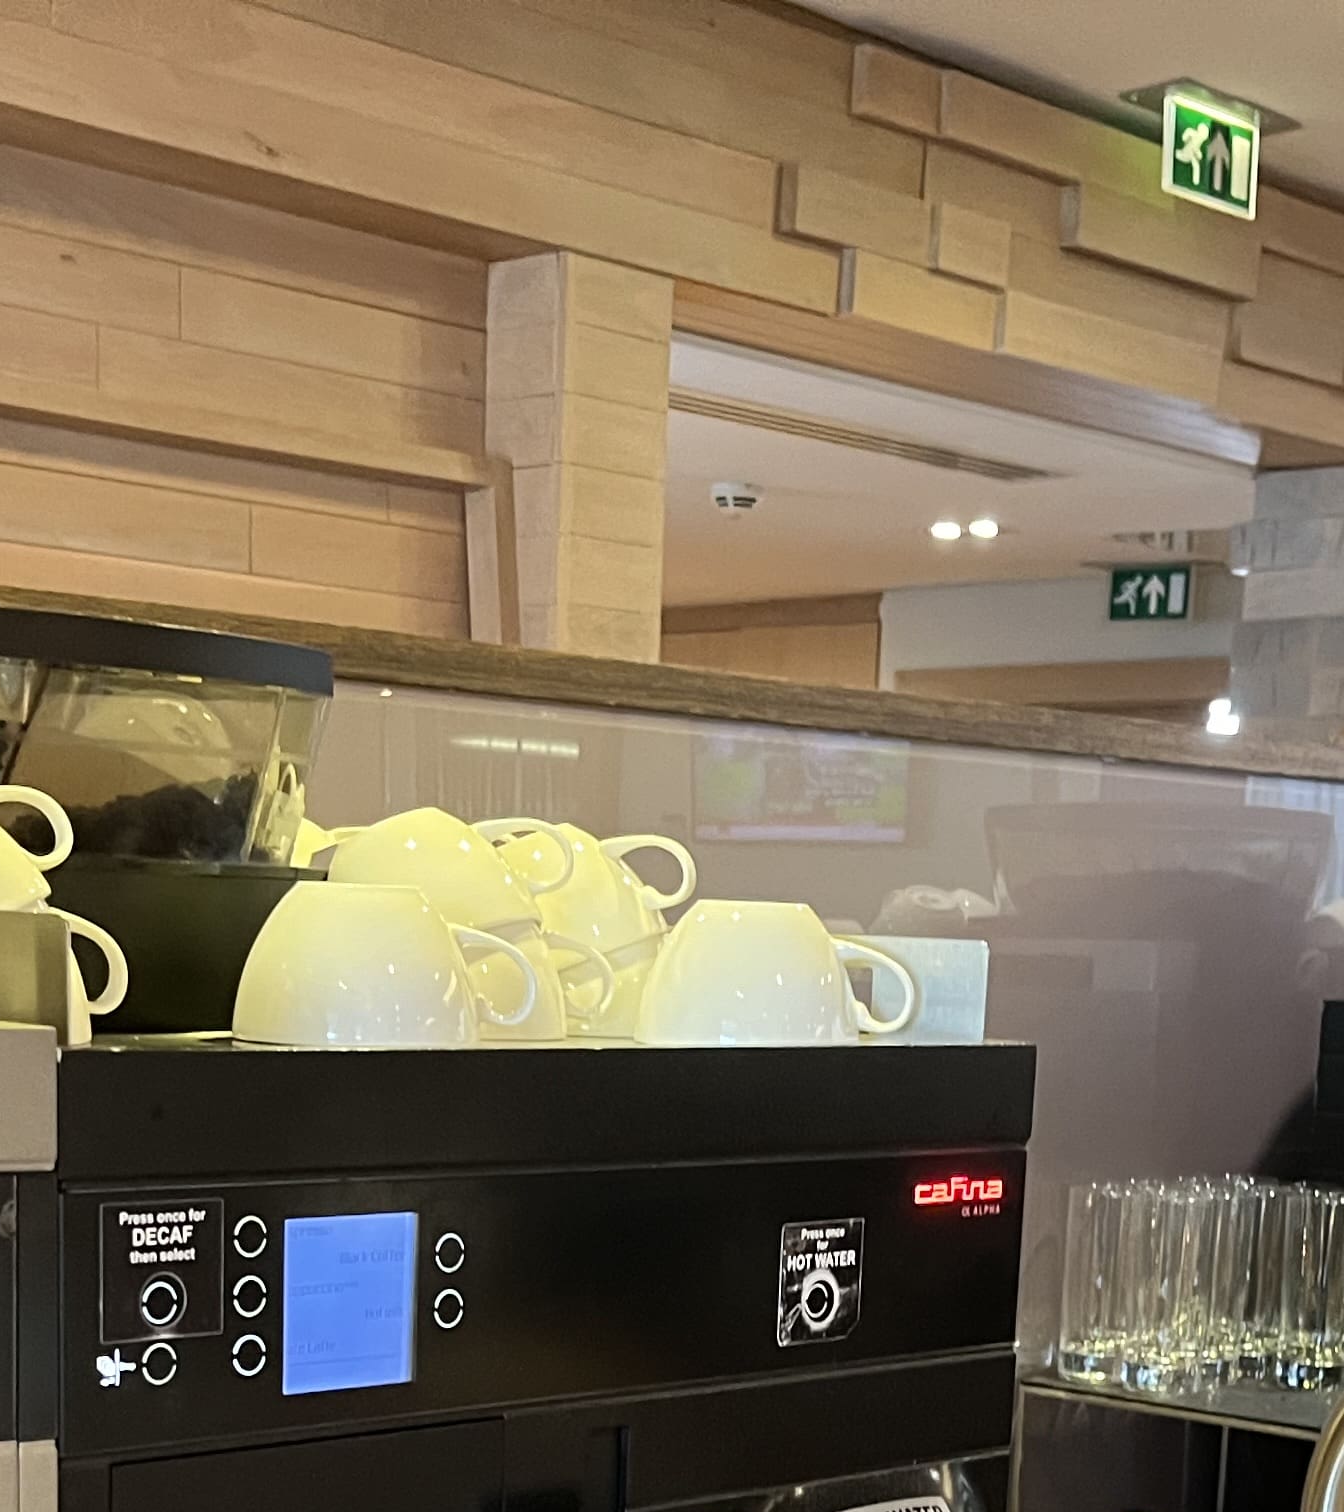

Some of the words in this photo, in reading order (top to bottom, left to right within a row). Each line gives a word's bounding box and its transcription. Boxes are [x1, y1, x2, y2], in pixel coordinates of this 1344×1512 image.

[914, 1176, 1003, 1205] cafina
[119, 1211, 154, 1226] Press
[156, 1211, 186, 1224] once
[188, 1208, 206, 1222] for
[972, 1204, 1001, 1217] ALPHA
[132, 1225, 194, 1247] DECAF
[800, 1228, 824, 1241] Press
[825, 1228, 845, 1239] once
[817, 1239, 829, 1251] for
[129, 1250, 157, 1264] then
[159, 1247, 196, 1262] select
[787, 1253, 813, 1272] HOT
[814, 1249, 856, 1268] WATER
